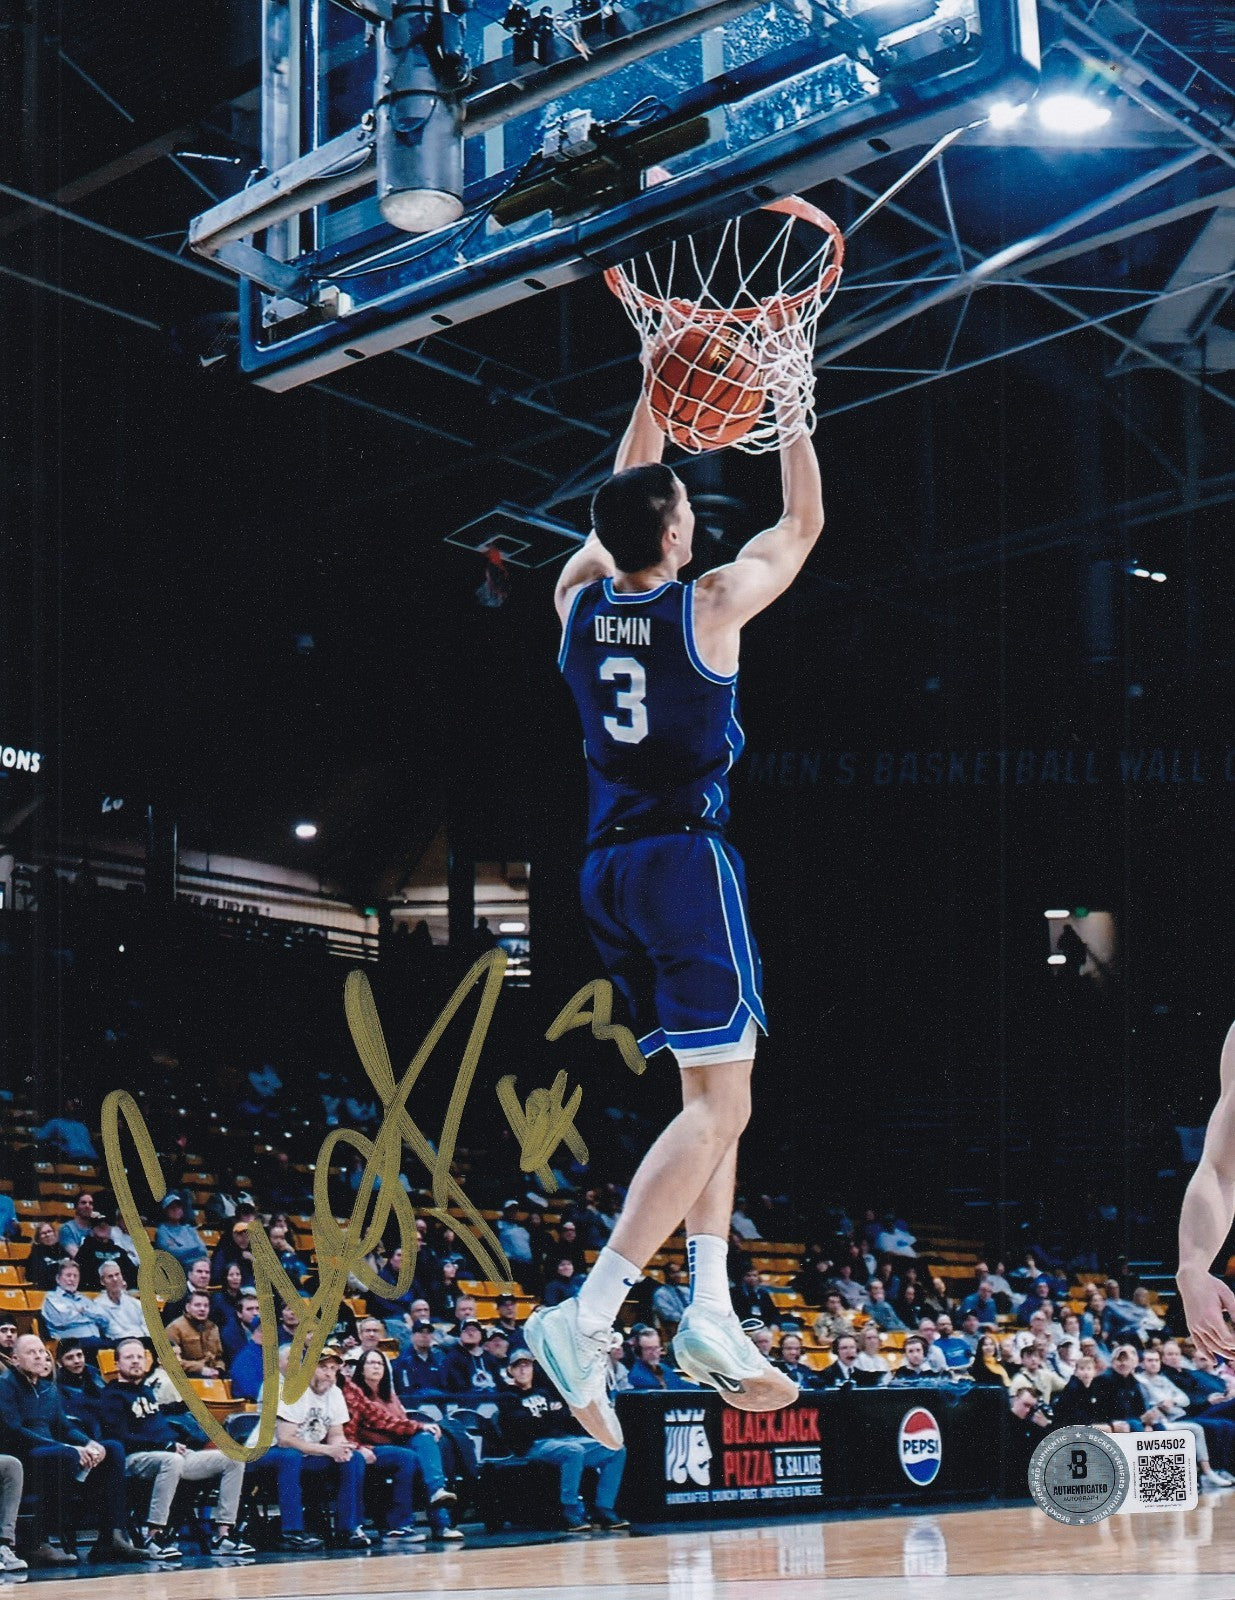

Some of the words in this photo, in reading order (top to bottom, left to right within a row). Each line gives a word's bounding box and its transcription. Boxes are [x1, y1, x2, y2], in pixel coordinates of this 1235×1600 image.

[594, 615, 651, 645] DEMIN
[599, 656, 649, 744] 3
[748, 751, 857, 786] MEN'S
[873, 749, 1101, 785] BASKETBALL
[1120, 748, 1206, 784] WALL
[721, 1408, 822, 1445] BLACKJACK
[903, 1439, 939, 1455] PEPSI
[1088, 1434, 1117, 1455] BECKETT
[1136, 1438, 1186, 1451] BW54502
[723, 1449, 775, 1486] PIZZA
[785, 1454, 822, 1477] SALADS
[1114, 1455, 1125, 1489] VERIFIED
[1053, 1483, 1108, 1496] AUTHENTICATED
[1092, 1490, 1123, 1522] AUTHENTIC
